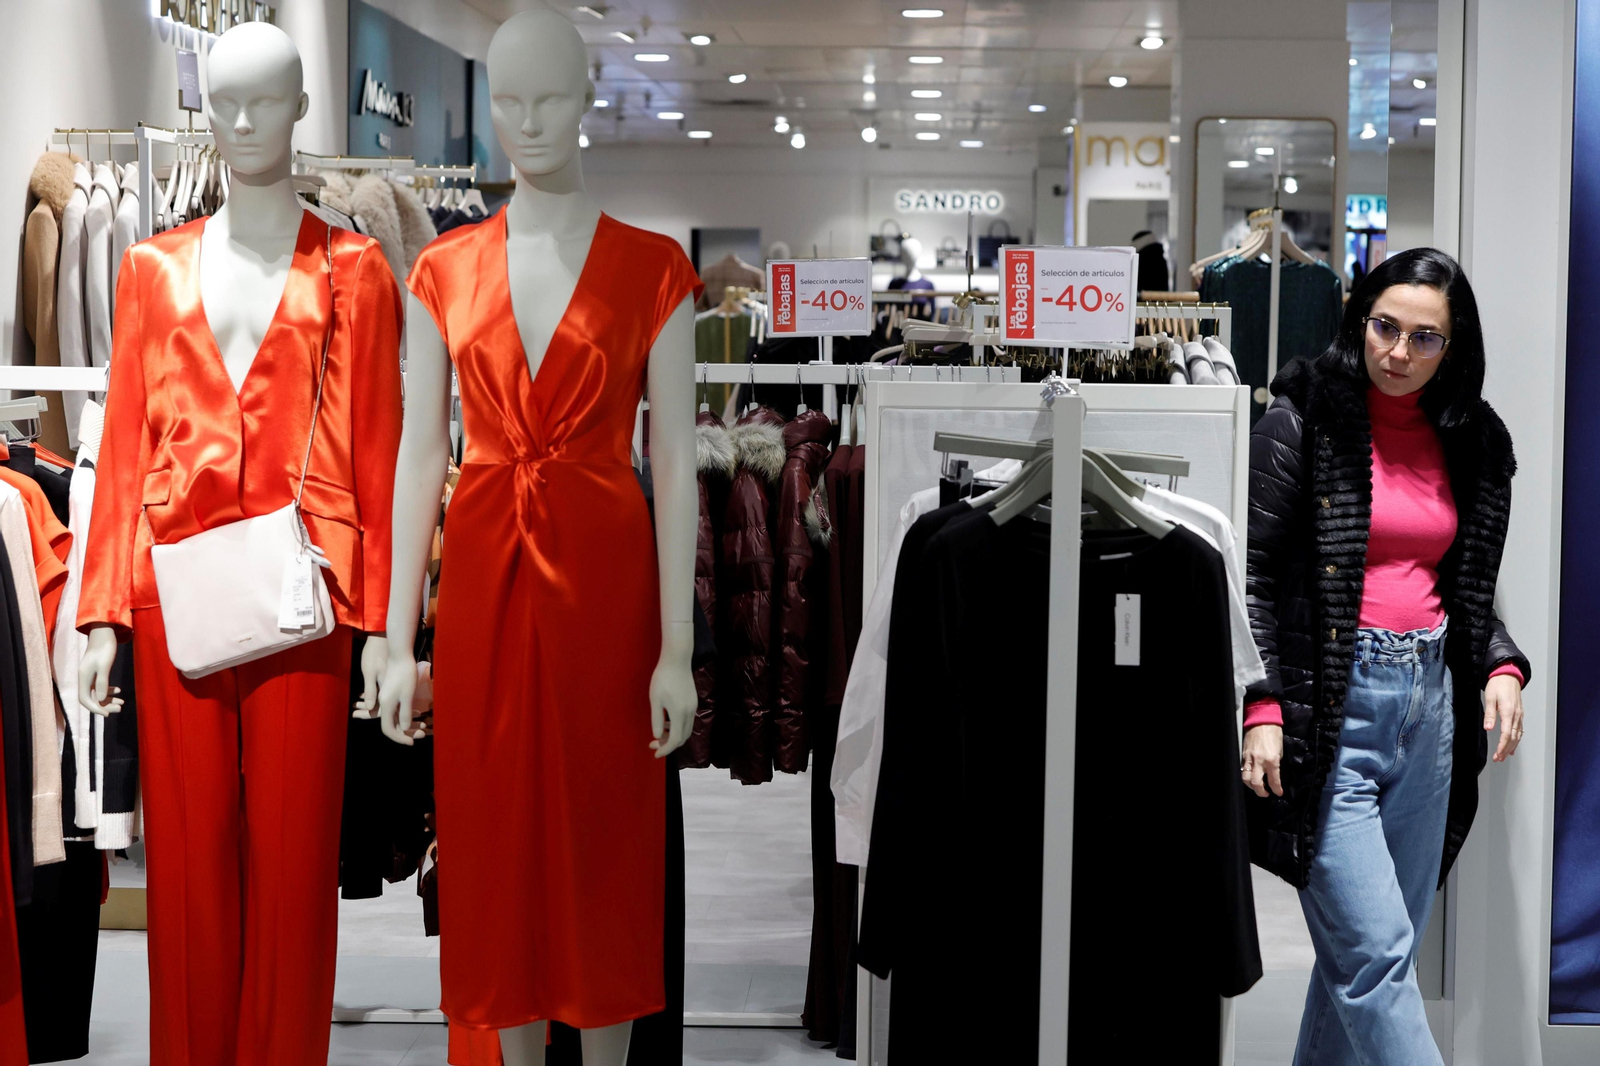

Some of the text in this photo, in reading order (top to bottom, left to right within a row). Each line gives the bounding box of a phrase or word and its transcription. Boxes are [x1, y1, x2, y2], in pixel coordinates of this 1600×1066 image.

[899, 192, 1000, 211] SANDRO
[1041, 269, 1125, 277] Selección de artículos
[778, 274, 793, 325] rebajas
[801, 290, 865, 311] -40%
[1012, 262, 1031, 330] rebajas
[1041, 284, 1125, 313] -40%
